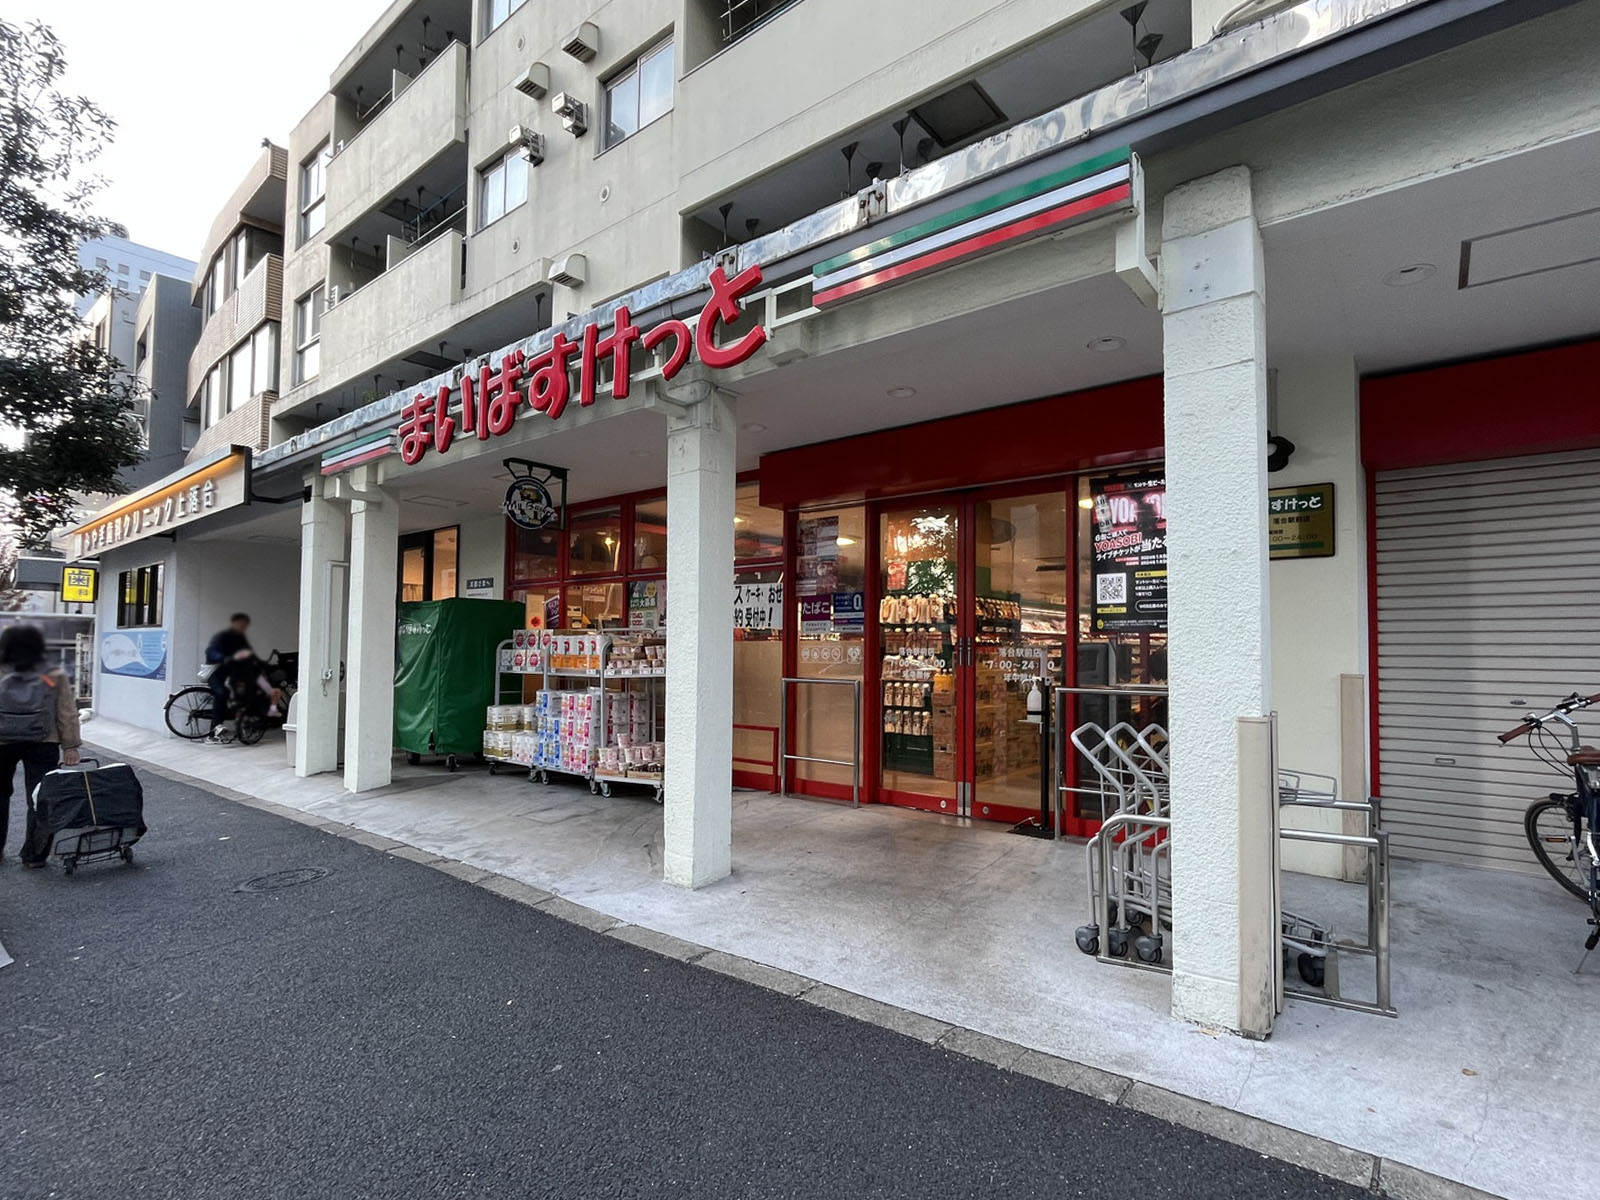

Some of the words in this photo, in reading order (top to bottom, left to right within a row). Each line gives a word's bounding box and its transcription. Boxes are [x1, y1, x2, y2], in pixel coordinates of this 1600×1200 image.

[399, 264, 767, 466] まいばすけっと
[1271, 496, 1321, 511] すけっと
[1094, 532, 1142, 553] YOASOBI
[803, 601, 831, 615] たばこ
